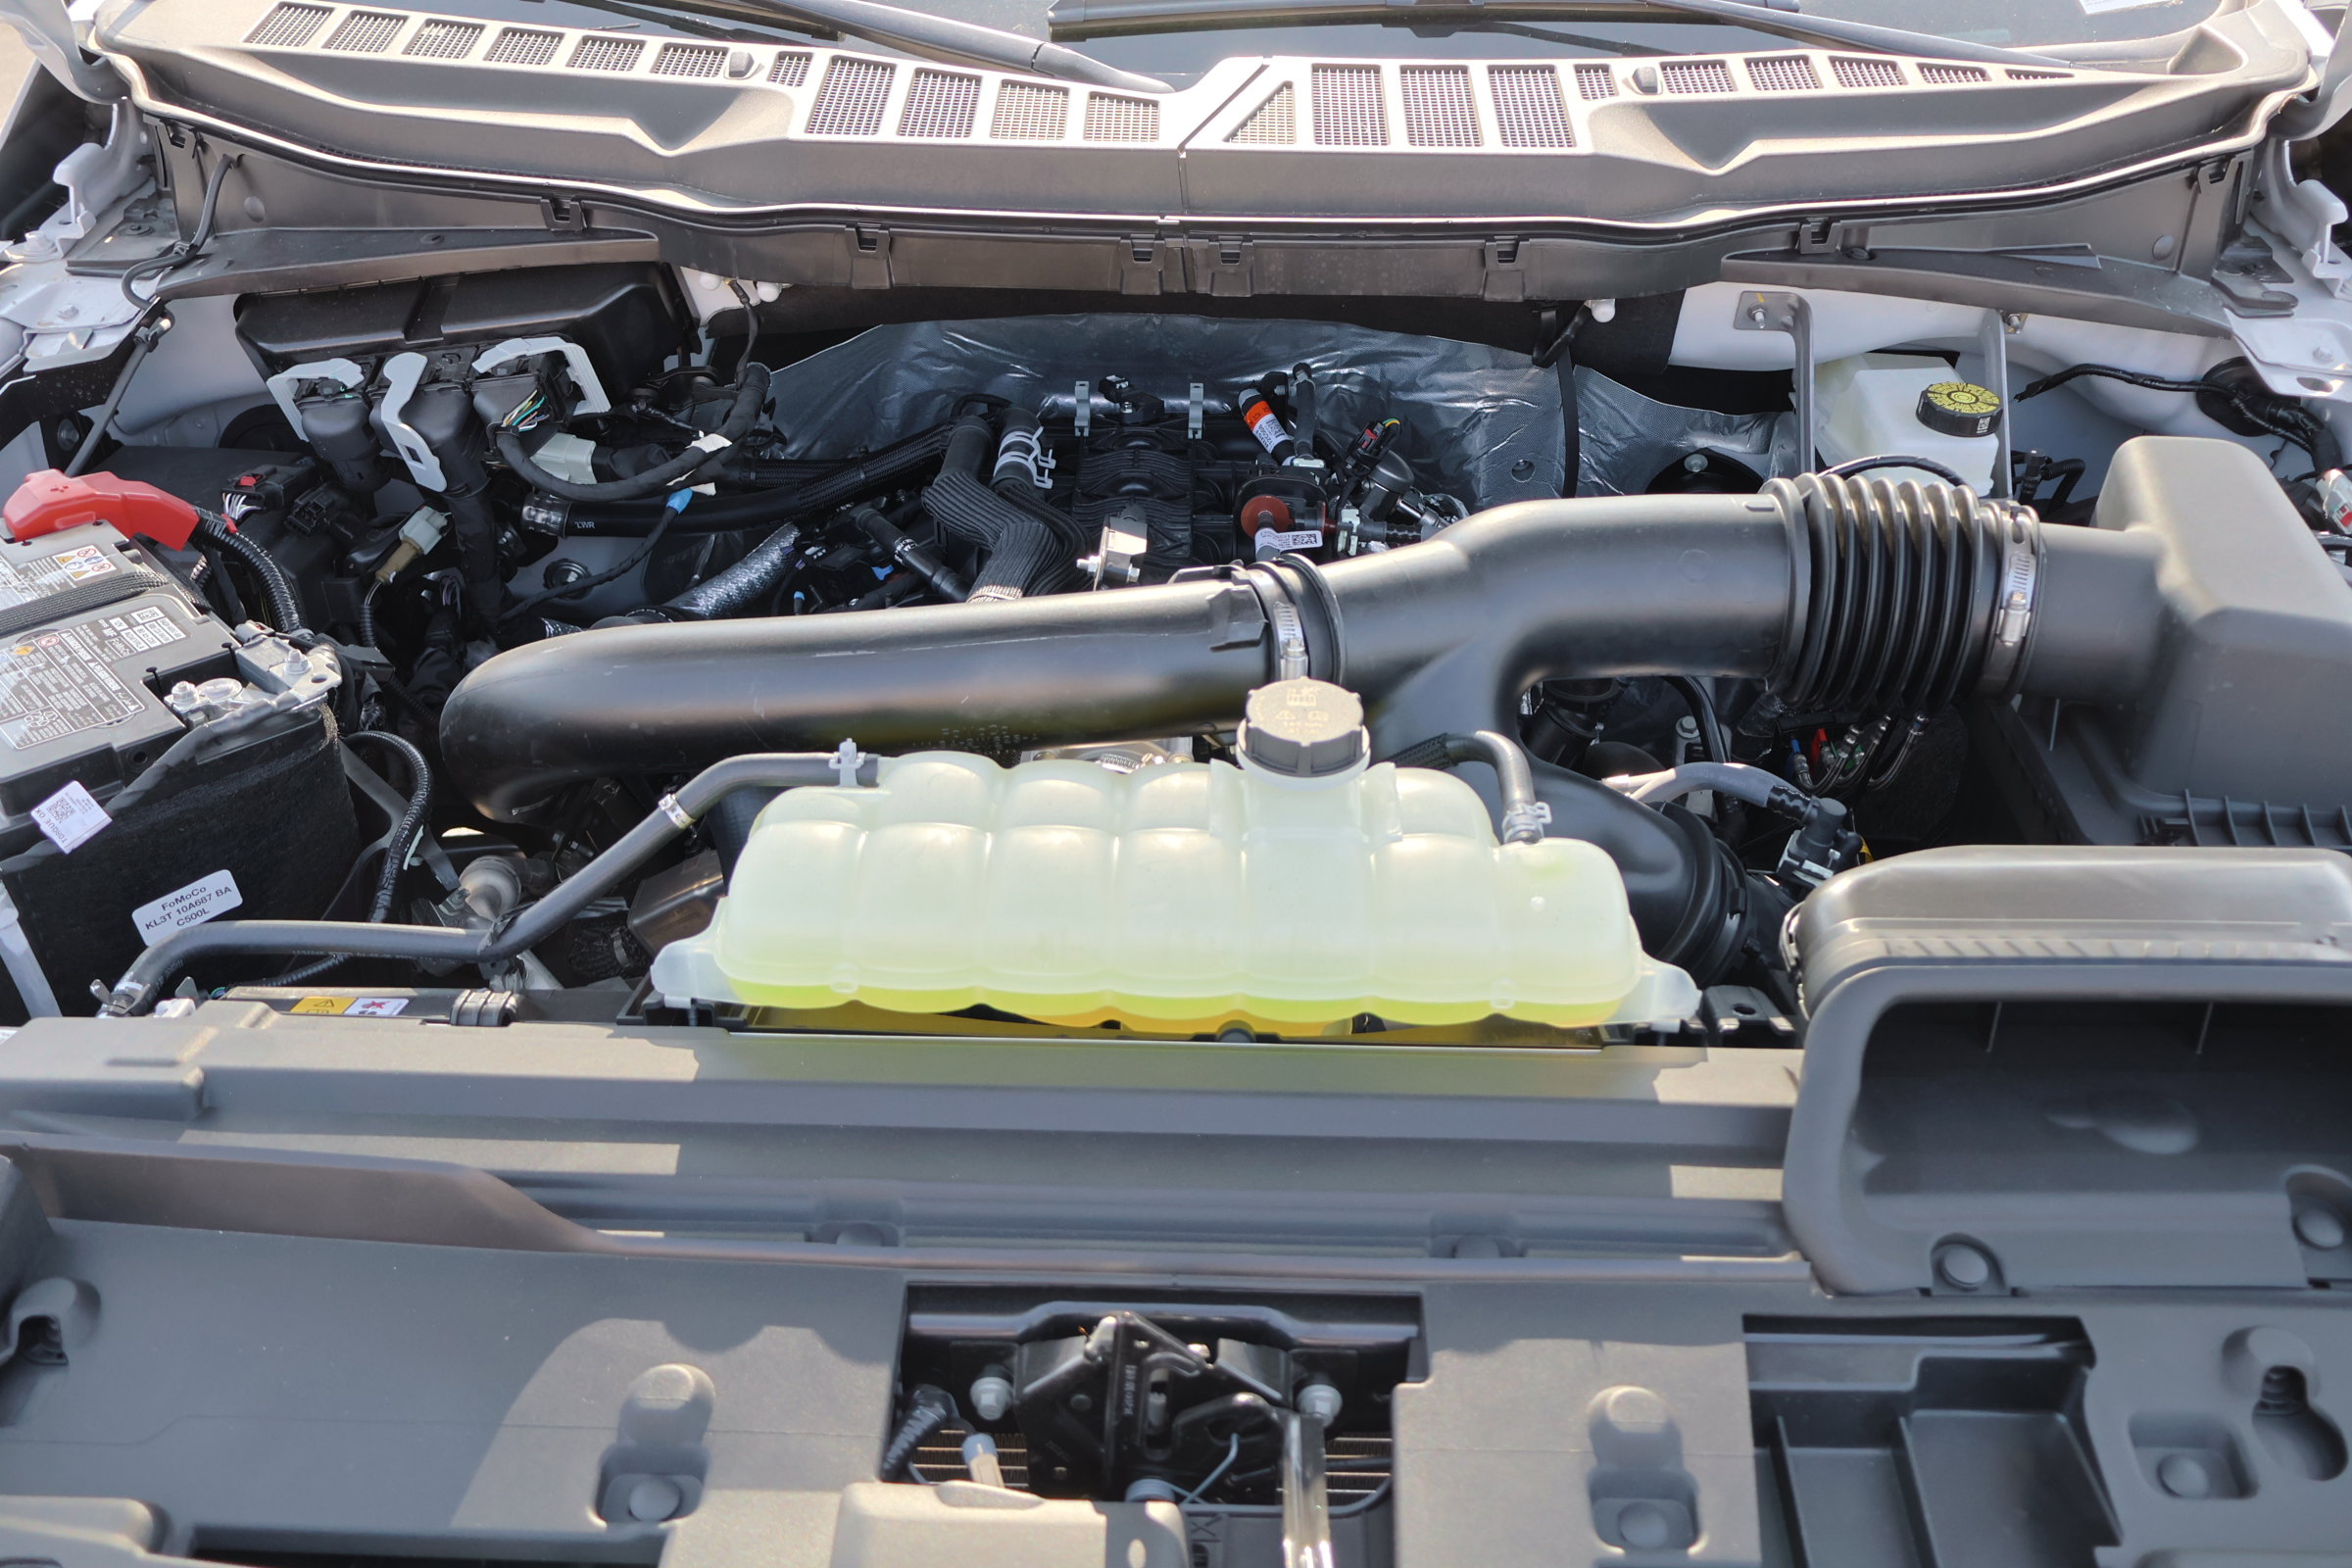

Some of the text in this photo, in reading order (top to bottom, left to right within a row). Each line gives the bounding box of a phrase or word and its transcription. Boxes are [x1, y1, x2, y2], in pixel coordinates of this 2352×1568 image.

[35, 808, 68, 844] TORQUE OK
[145, 886, 232, 930] KL3T 10A687 BA
[162, 887, 207, 910] FoMoCo
[176, 907, 210, 927] C500L
